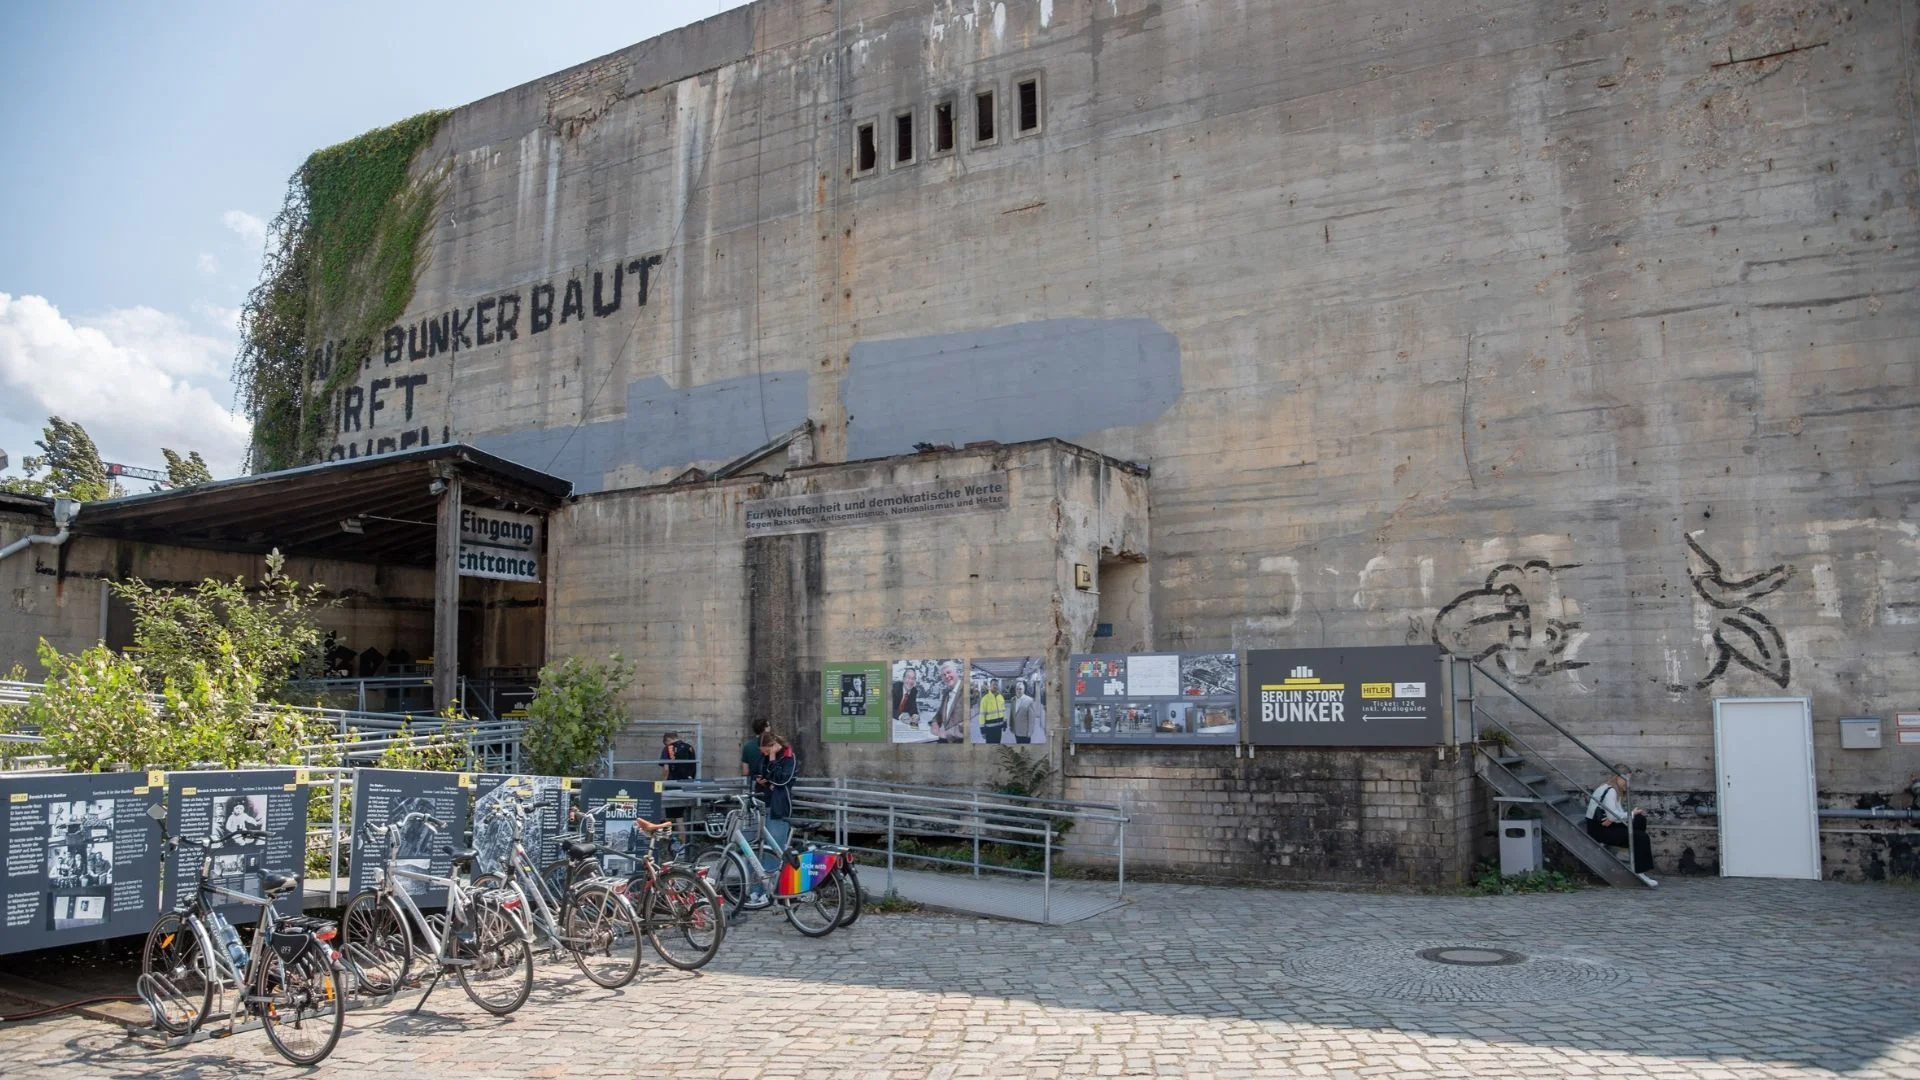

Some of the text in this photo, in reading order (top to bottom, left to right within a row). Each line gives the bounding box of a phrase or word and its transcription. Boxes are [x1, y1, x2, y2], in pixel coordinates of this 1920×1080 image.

[383, 293, 521, 368] BUNKER
[530, 254, 663, 335] BAUT
[334, 373, 428, 433] IRFT
[767, 501, 841, 518] Weltoffenheit
[844, 498, 866, 511] und
[869, 488, 961, 508] demokratische
[965, 483, 1003, 497] Werte
[957, 499, 974, 508] und
[460, 508, 534, 546] Eingang
[458, 546, 537, 577] Entrance
[1261, 689, 1345, 703] BERLIN STORY
[1363, 686, 1392, 694] HITLER
[1261, 702, 1345, 722] BUNKER
[1382, 705, 1427, 713] Audioguide
[153, 775, 159, 783] 5
